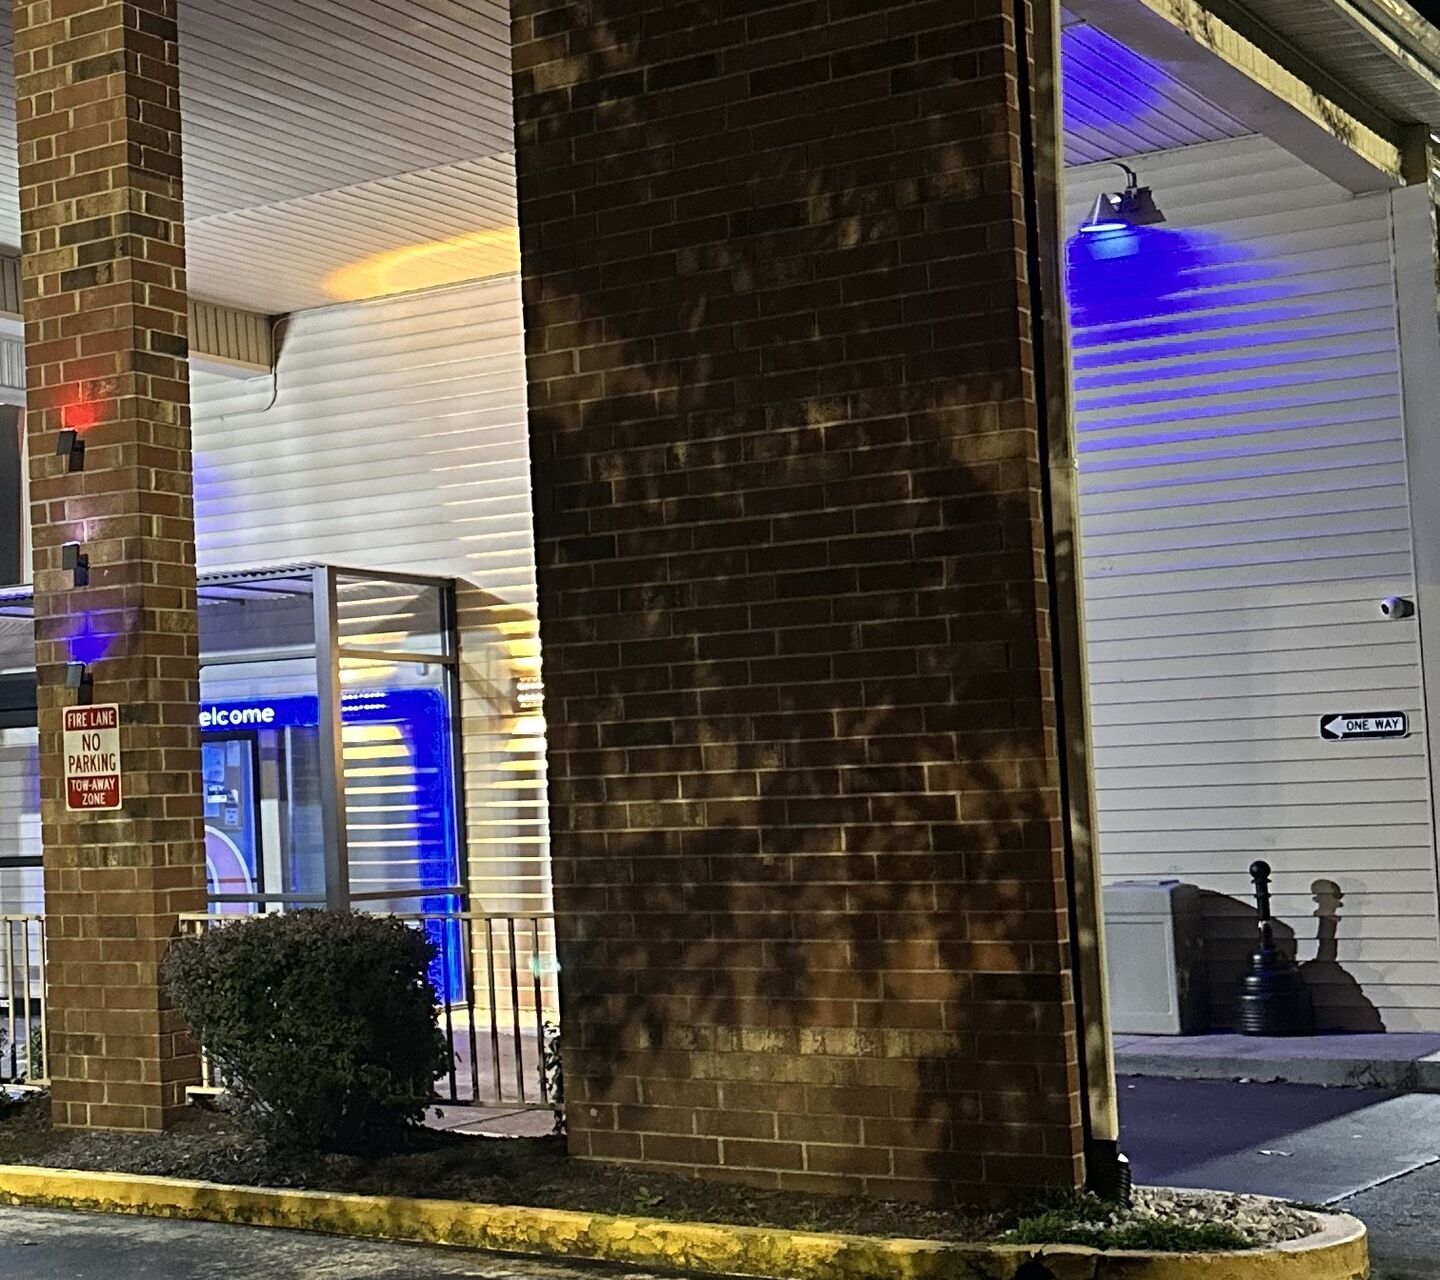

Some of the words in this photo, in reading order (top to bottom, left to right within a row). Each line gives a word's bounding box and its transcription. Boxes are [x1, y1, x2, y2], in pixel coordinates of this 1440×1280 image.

[67, 713, 88, 728] FIRE
[90, 710, 114, 726] LANE
[199, 706, 275, 726] elcome
[1346, 720, 1369, 731] ONE
[1375, 719, 1400, 730] WAY
[82, 733, 100, 751] NO
[68, 753, 116, 773] PARKING
[71, 778, 115, 792] TOW-AWAY
[82, 793, 106, 805] ZONE
